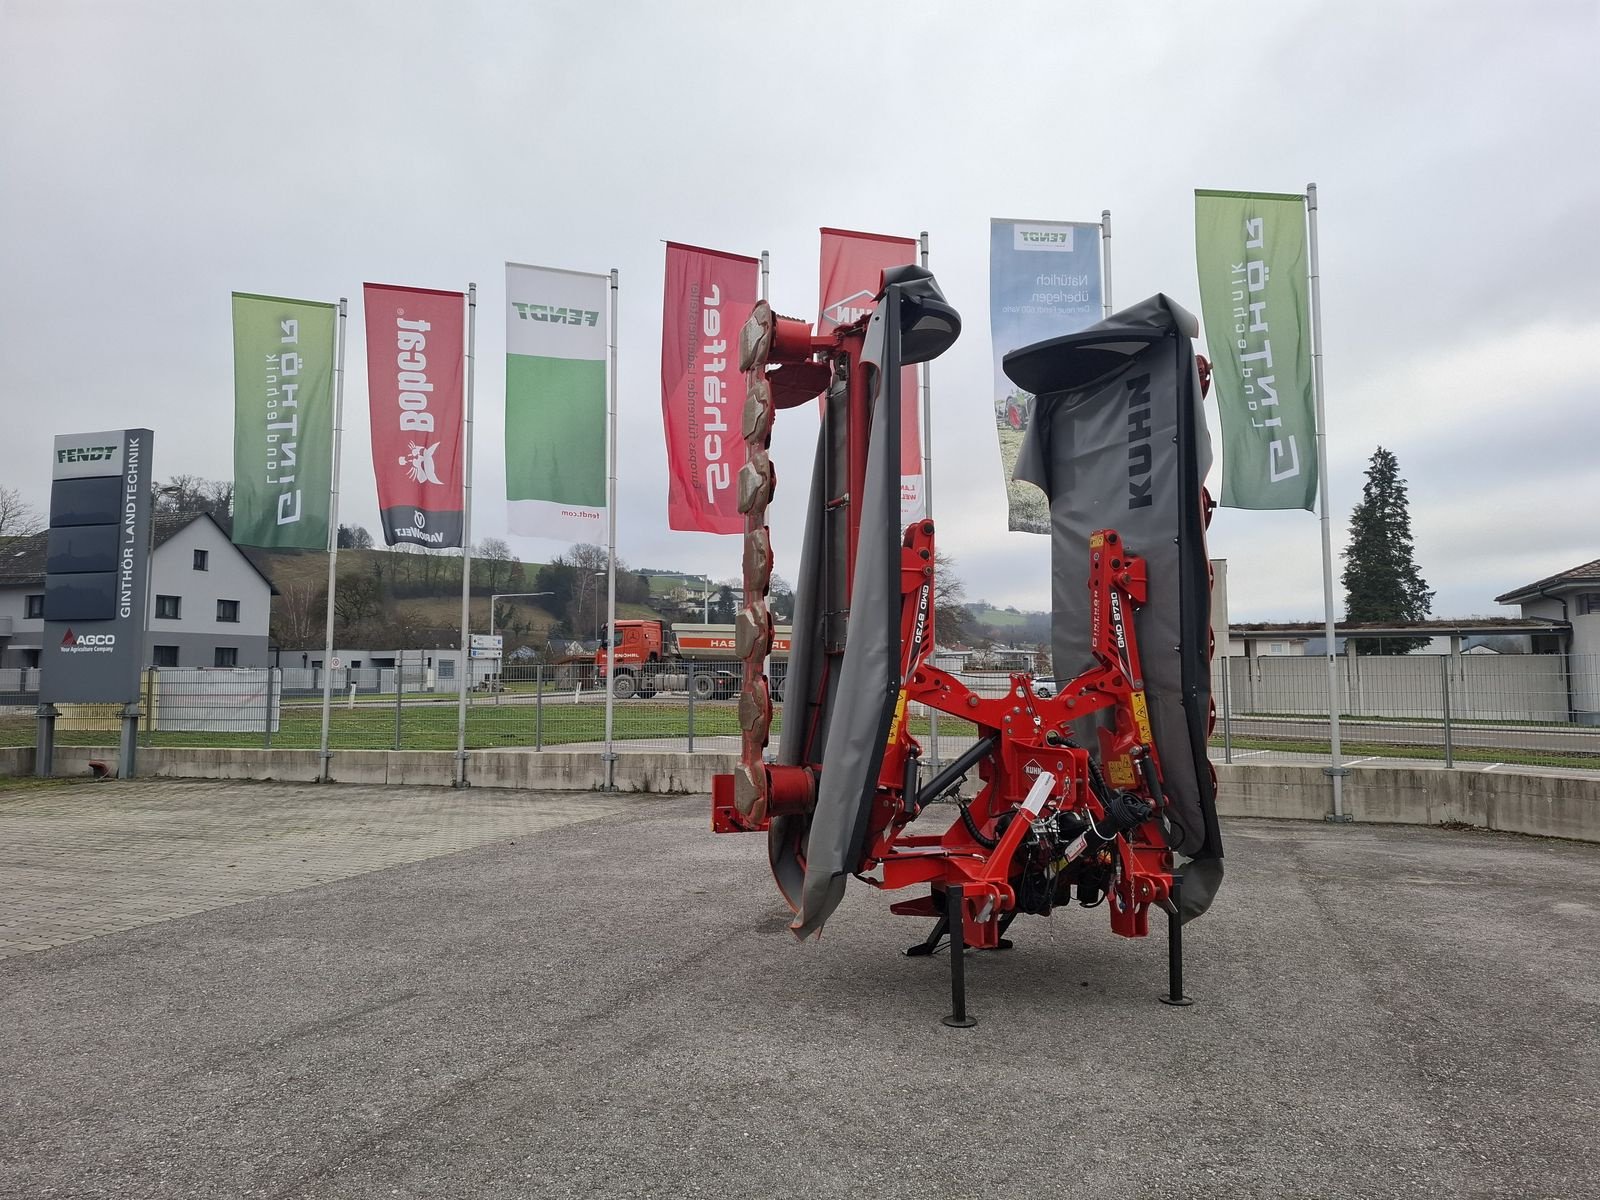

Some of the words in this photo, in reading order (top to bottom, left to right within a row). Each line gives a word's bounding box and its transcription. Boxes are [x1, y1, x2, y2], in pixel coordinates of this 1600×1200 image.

[57, 446, 117, 463] FENDT
[1126, 372, 1152, 510] KUHN
[125, 438, 140, 543] LANDTECHNIK
[120, 548, 134, 618] GINTHÖR
[920, 584, 930, 610] GMD
[1110, 592, 1121, 621] 8730
[76, 634, 115, 645] AGCO
[914, 613, 925, 644] 8730
[1115, 624, 1125, 648] GMD
[1025, 766, 1042, 775] KUHN
